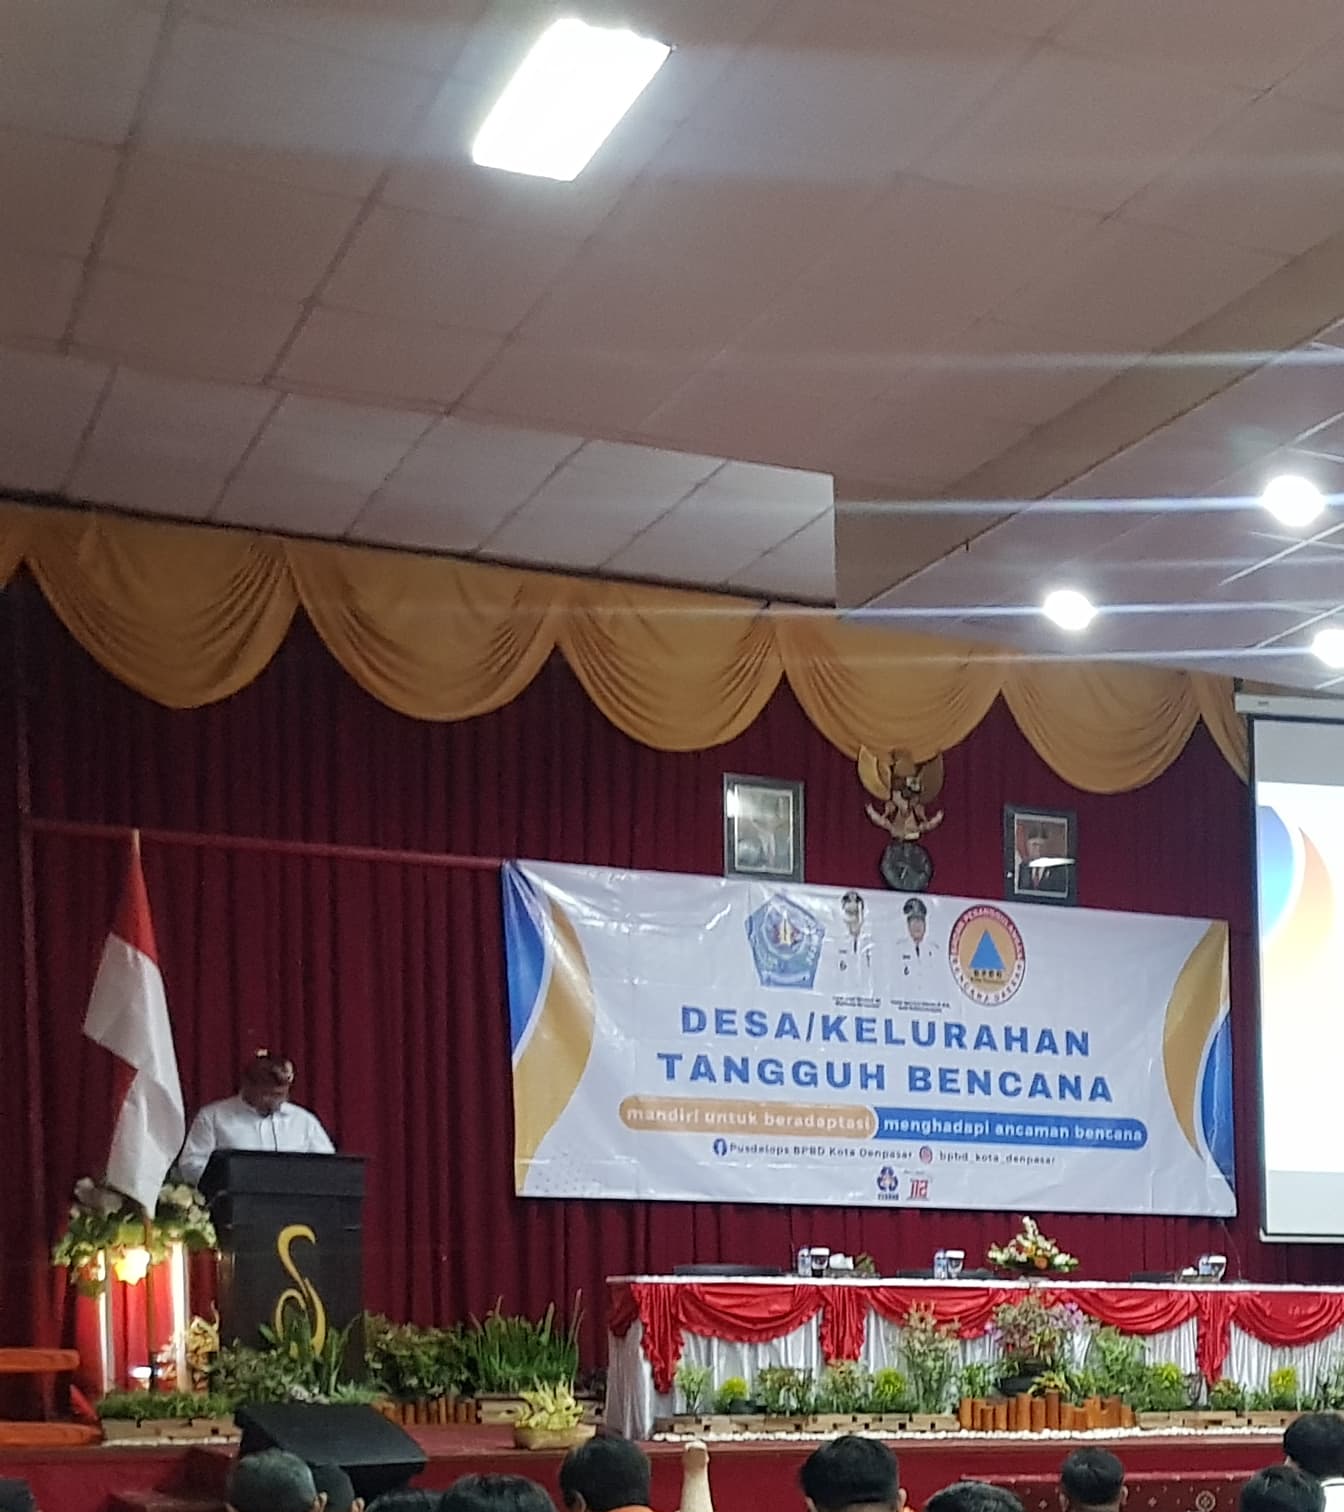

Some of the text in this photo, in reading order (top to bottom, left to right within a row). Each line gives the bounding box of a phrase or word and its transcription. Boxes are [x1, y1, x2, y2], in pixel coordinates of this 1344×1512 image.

[681, 1005, 1090, 1057] DESA/KELURAHAN
[657, 1052, 1113, 1102] TANGGUH BENCANA
[626, 1106, 1142, 1142] mandiri untuk beradaptasi menghadapi ancaman bencana
